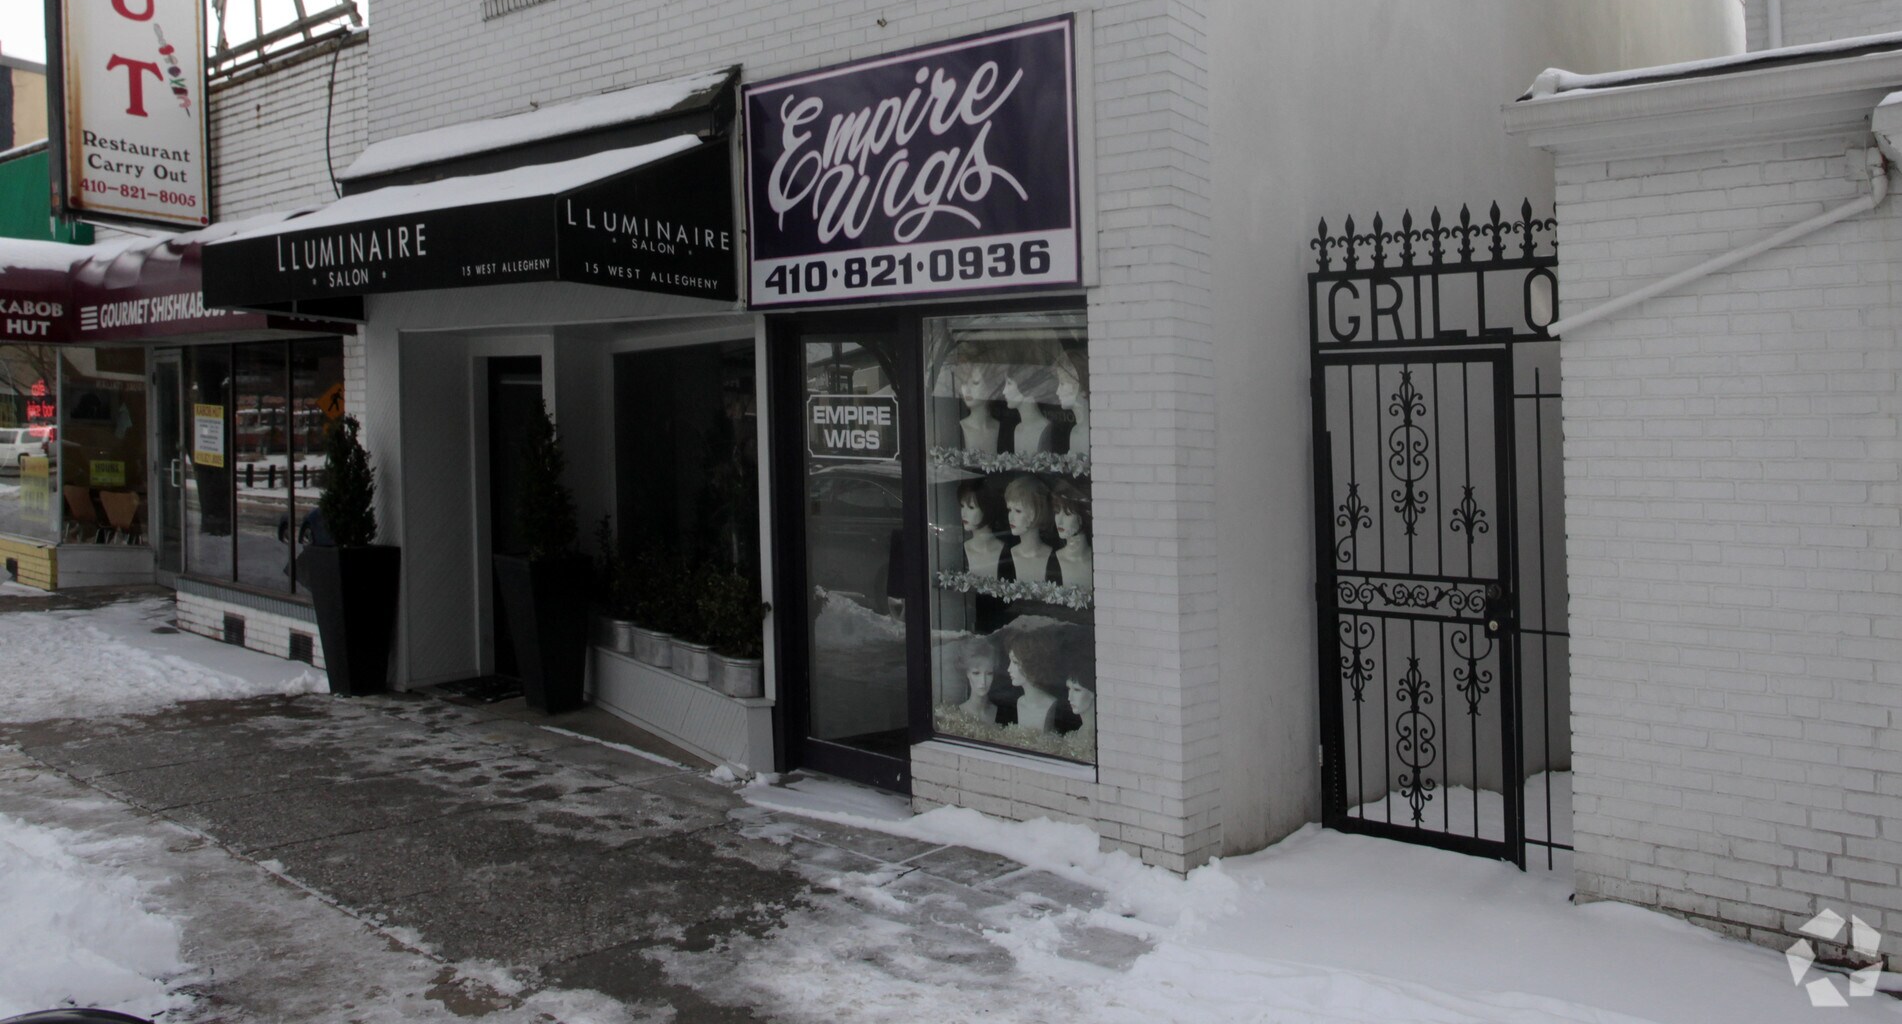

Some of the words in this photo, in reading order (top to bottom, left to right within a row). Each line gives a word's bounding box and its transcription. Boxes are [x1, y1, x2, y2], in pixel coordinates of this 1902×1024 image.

[82, 130, 191, 163] Restaurant
[768, 61, 1024, 232] Empire
[87, 153, 144, 179] Carry
[153, 163, 188, 183] Out
[812, 120, 1029, 244] Wigs
[79, 178, 197, 207] 410-821-8005
[566, 199, 731, 251] LLUMINAIRE
[277, 223, 428, 272] LLUMINAIRE
[631, 238, 676, 255] SALON
[328, 268, 370, 288] SALON
[462, 265, 472, 276] 15
[475, 263, 497, 275] WEST
[501, 258, 551, 273] ALLEGHENY
[585, 262, 599, 274] 15
[608, 265, 640, 279] WEST
[650, 272, 719, 290] ALLEGHENY
[100, 299, 150, 328] GOURMET
[1328, 267, 1559, 343] GRILLO
[6, 318, 51, 336] HUT
[813, 405, 891, 426] EMPIRE
[824, 429, 880, 450] WIGS
